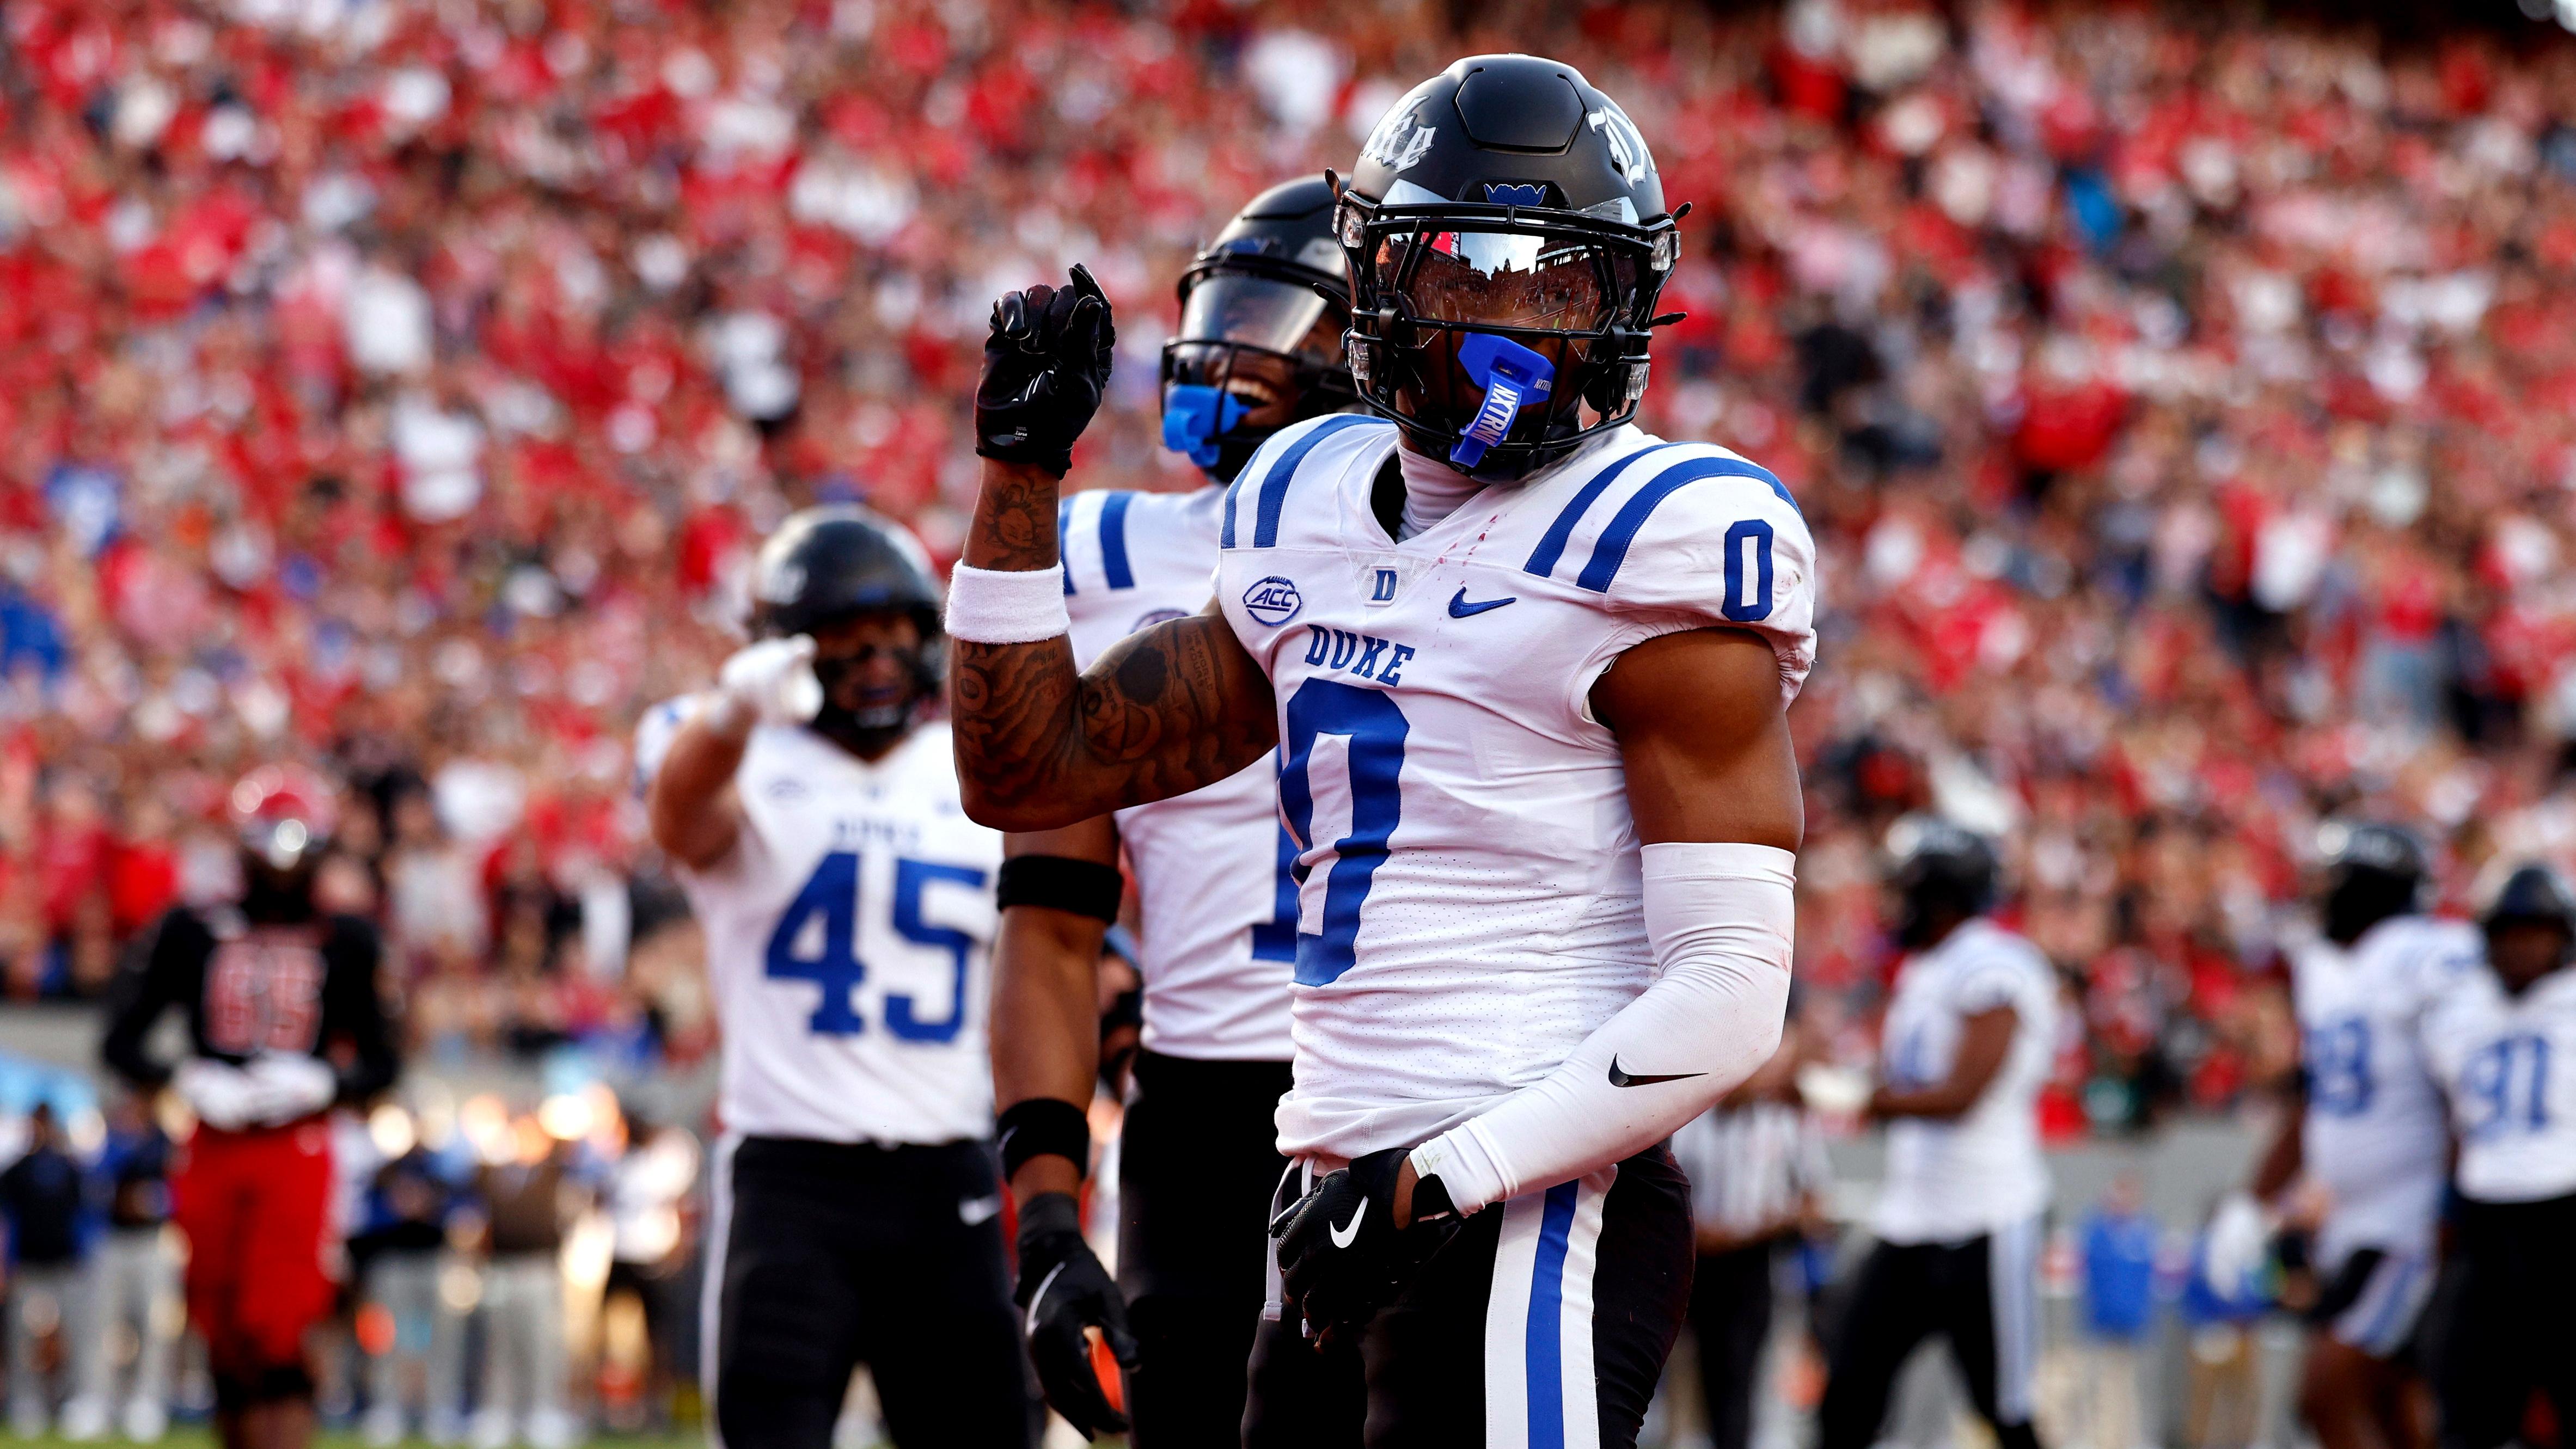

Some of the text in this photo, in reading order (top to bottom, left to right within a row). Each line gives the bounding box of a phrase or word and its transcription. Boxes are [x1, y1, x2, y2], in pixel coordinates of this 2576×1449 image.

[1251, 588, 1297, 608] ACC
[1370, 570, 1397, 601] D
[1723, 518, 1773, 622] 0
[1305, 624, 1416, 687] DUKE
[1277, 677, 1410, 987] 0
[764, 850, 991, 1043] 45
